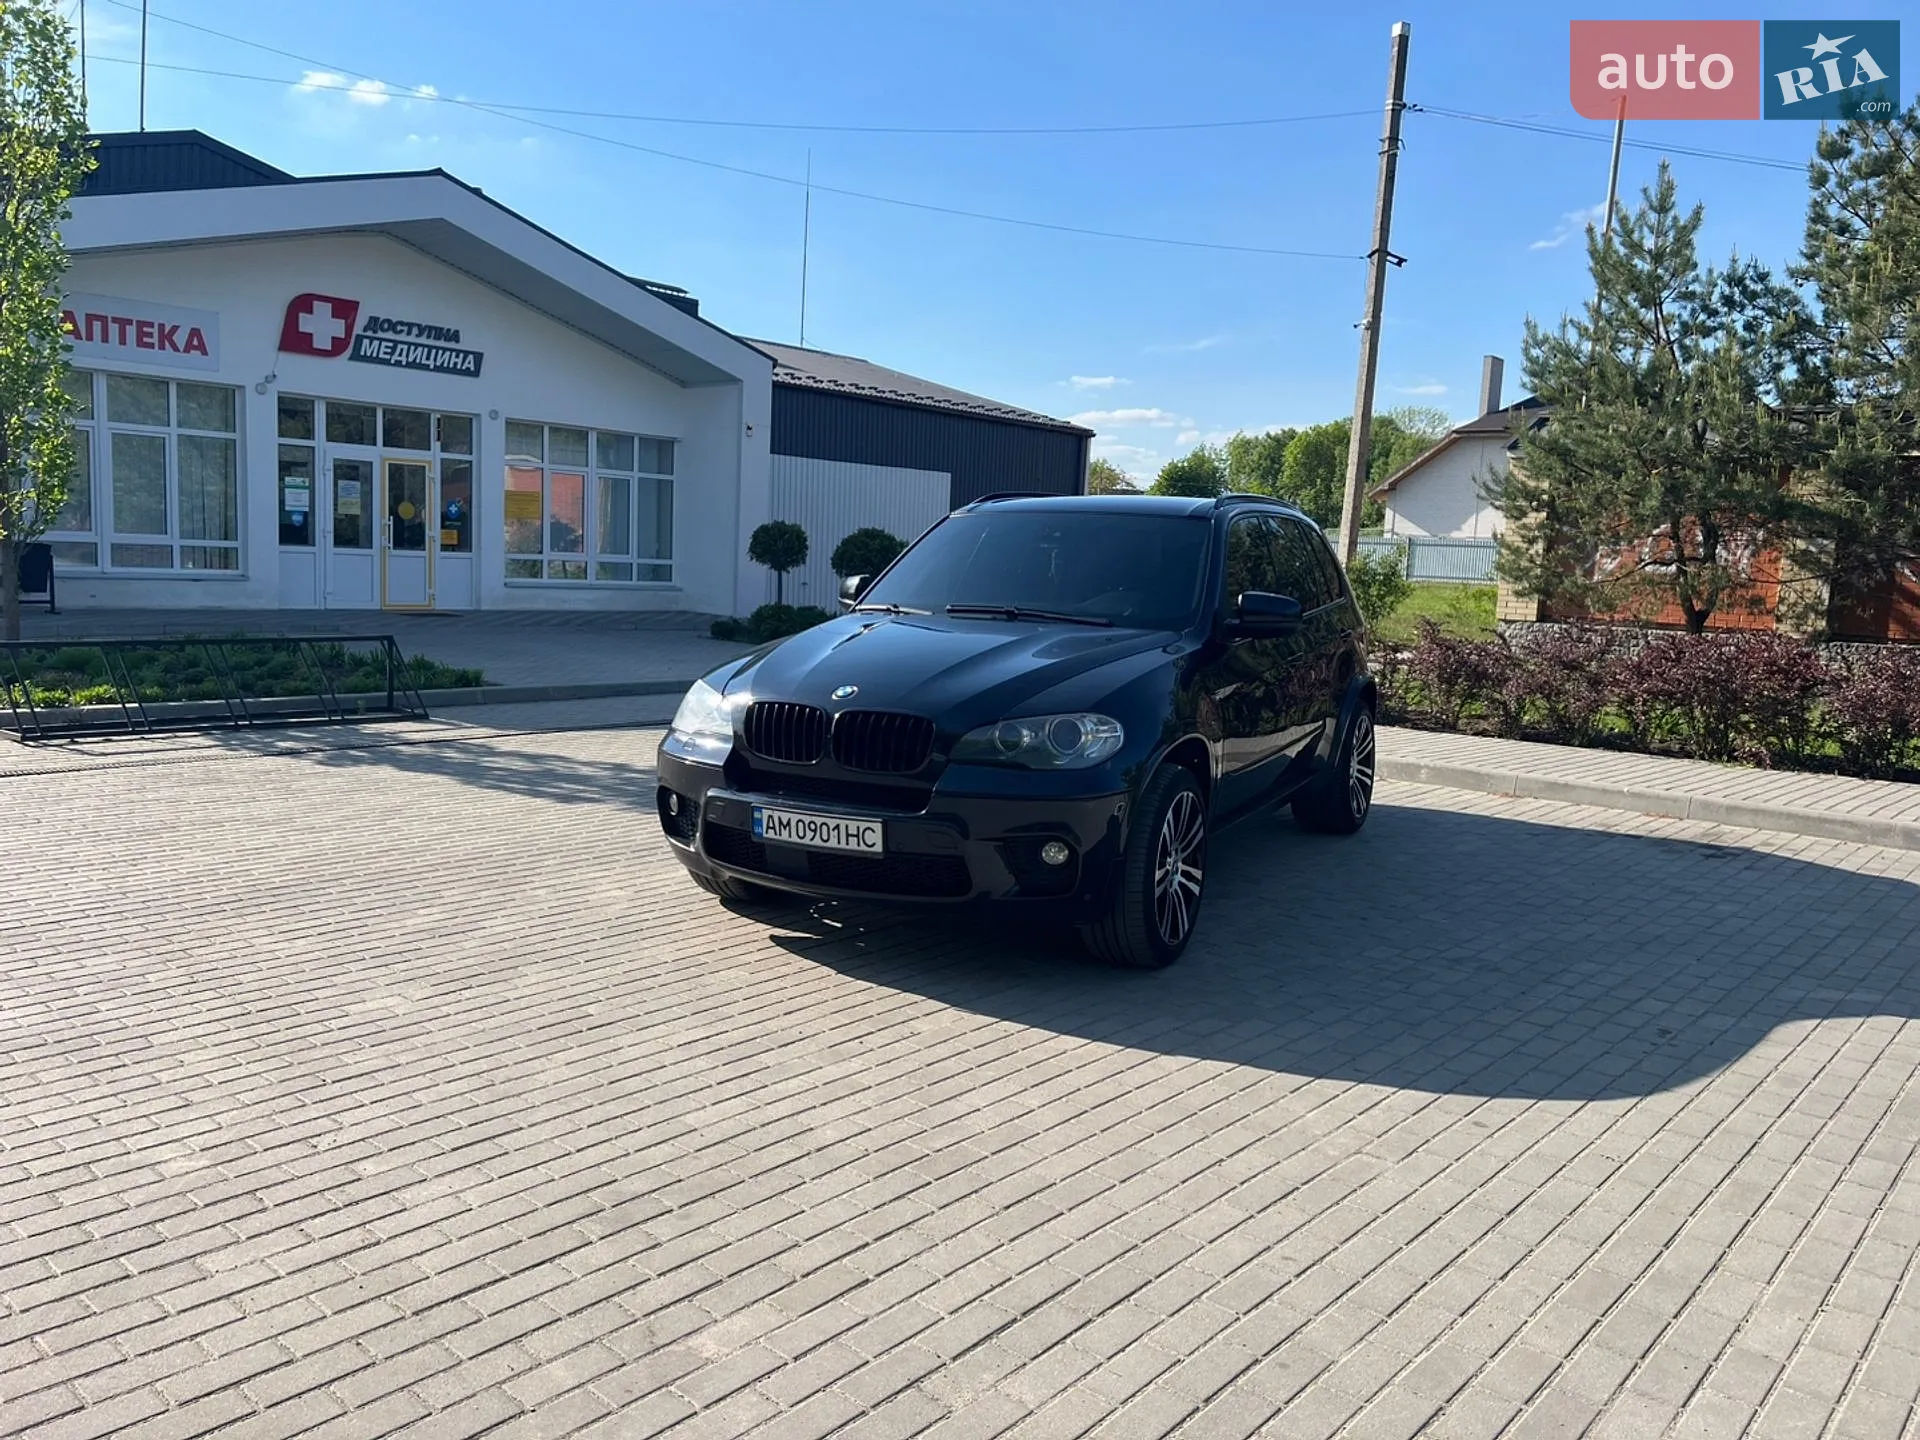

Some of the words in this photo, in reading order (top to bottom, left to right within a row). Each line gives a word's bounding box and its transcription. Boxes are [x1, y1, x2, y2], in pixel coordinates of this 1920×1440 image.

[60, 310, 209, 356] АПТЕКА
[363, 316, 461, 343] ДОСТУПНА
[360, 338, 475, 371] МЕДИЦИНА
